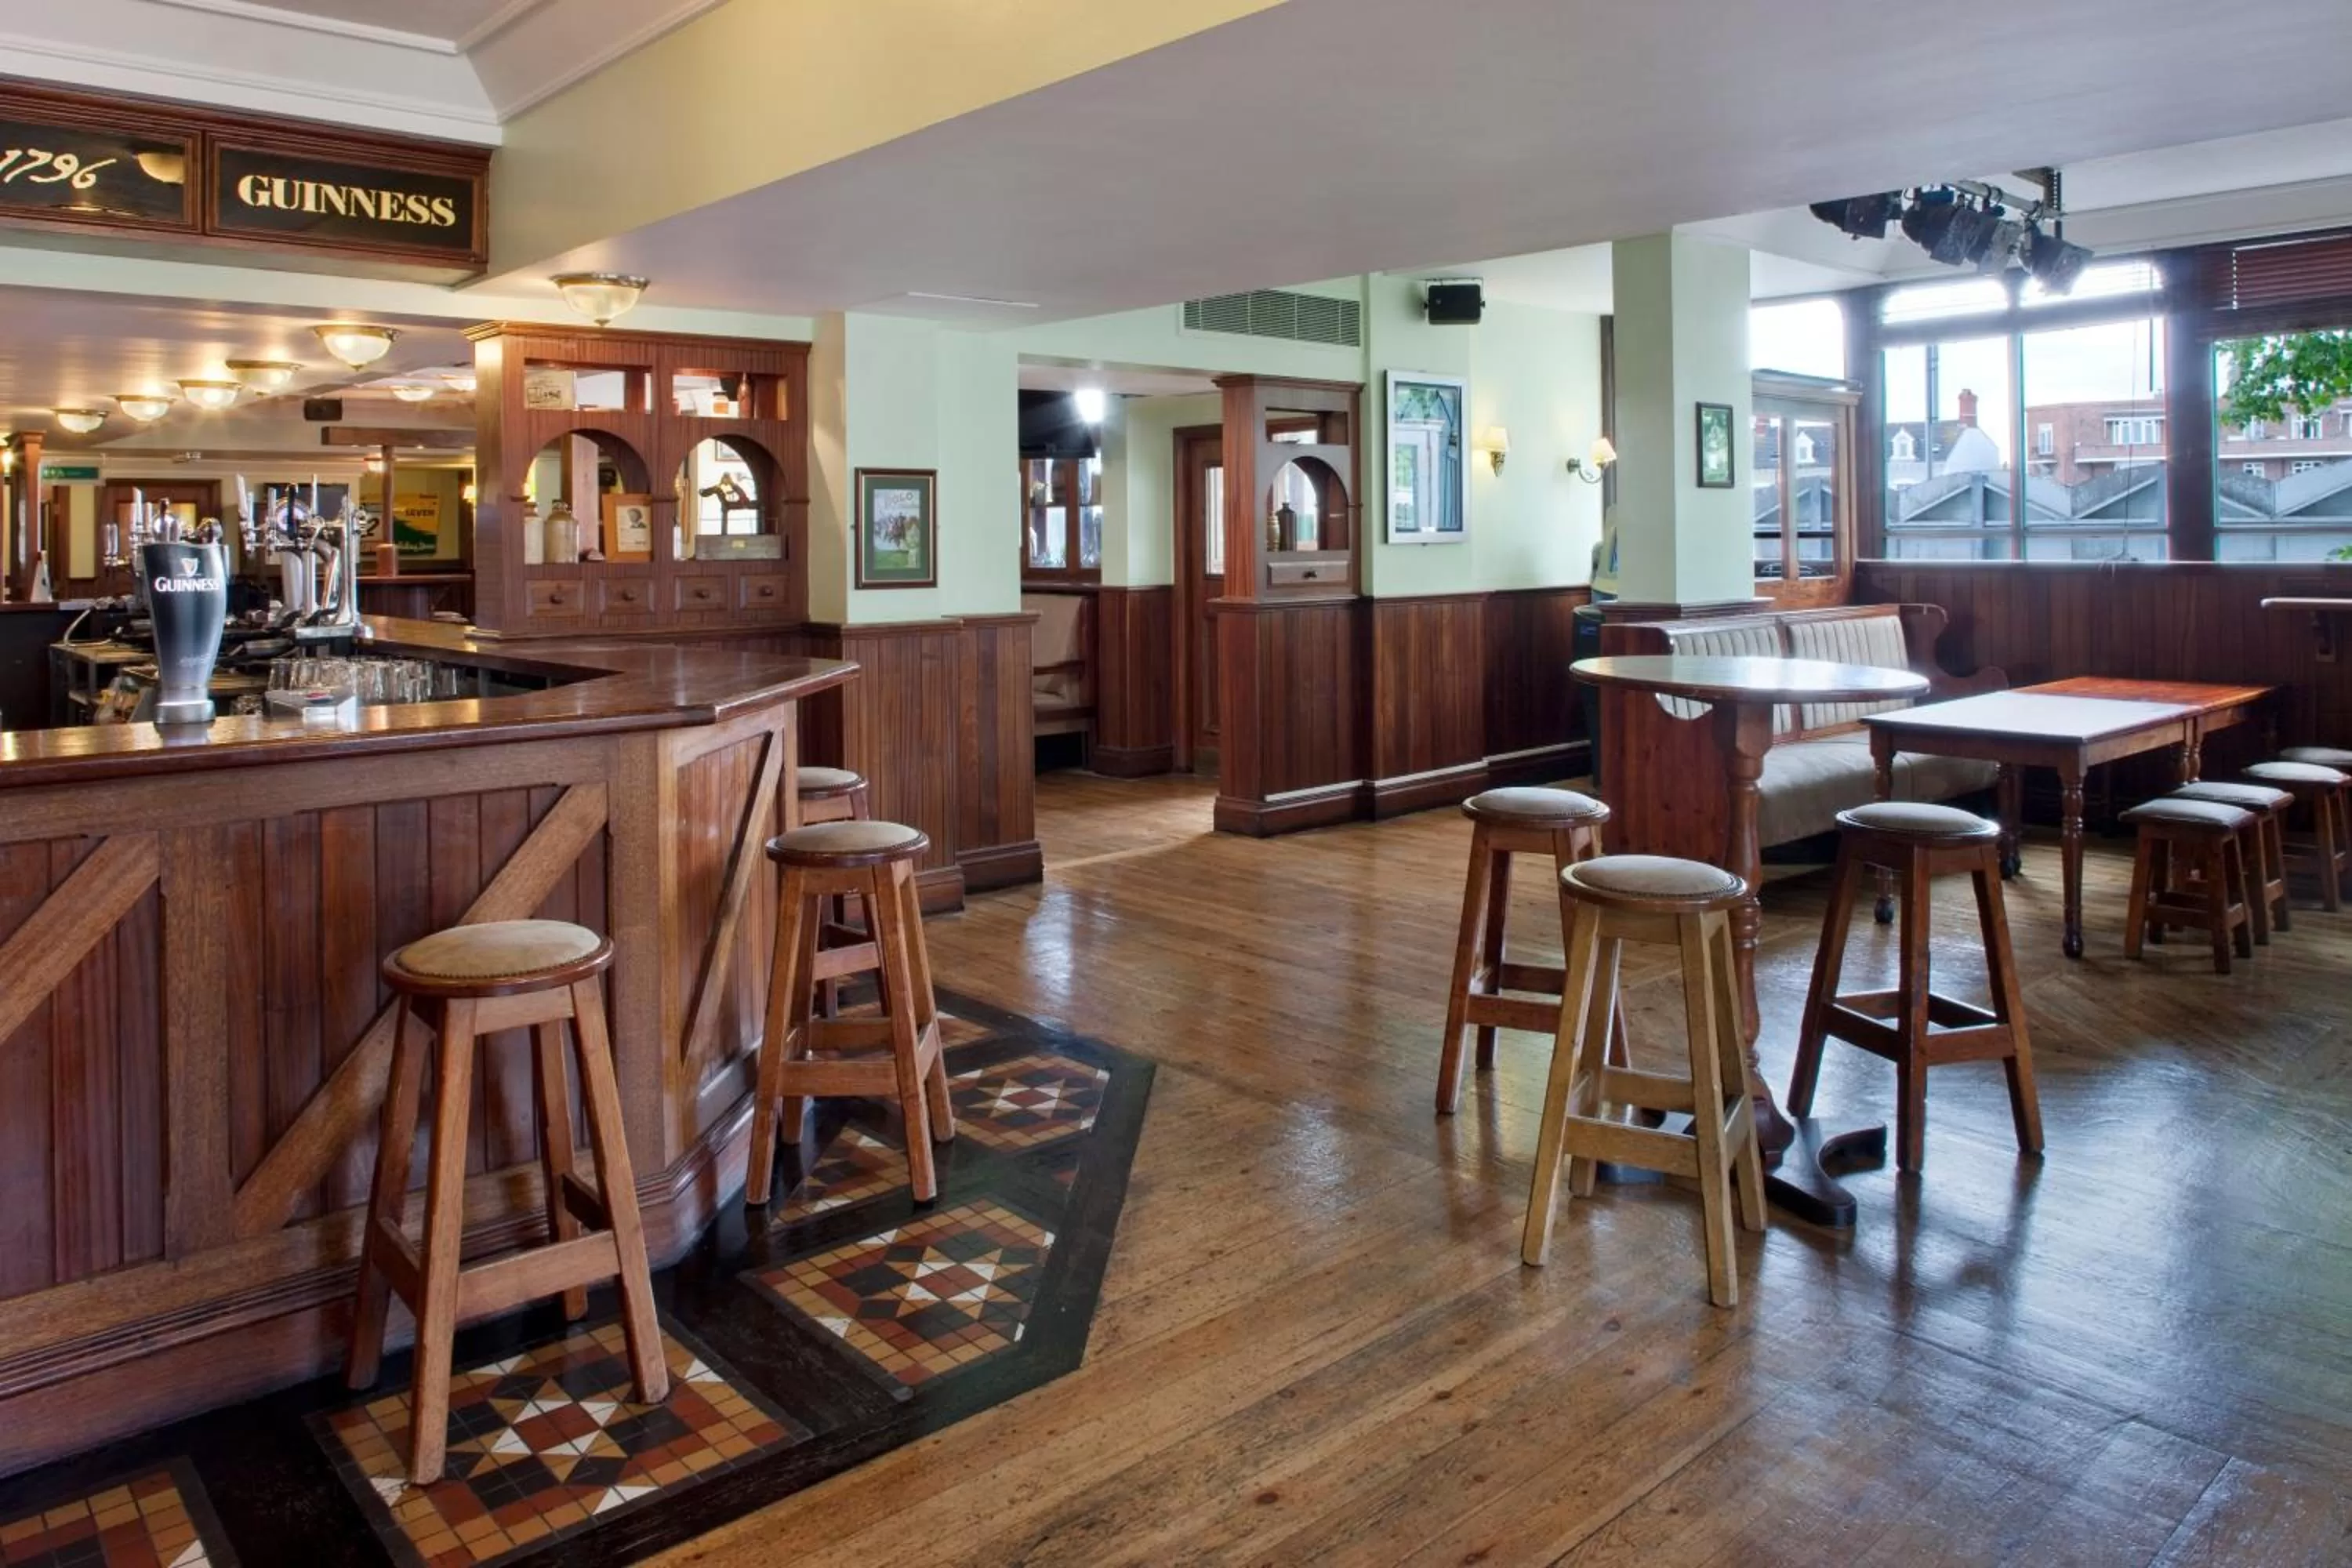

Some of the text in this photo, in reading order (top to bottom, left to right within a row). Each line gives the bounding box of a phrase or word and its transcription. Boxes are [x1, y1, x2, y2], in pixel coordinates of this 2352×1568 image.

[0, 148, 117, 189] 1796
[238, 175, 456, 227] GUINNESS
[154, 576, 220, 592] GUINNESS
